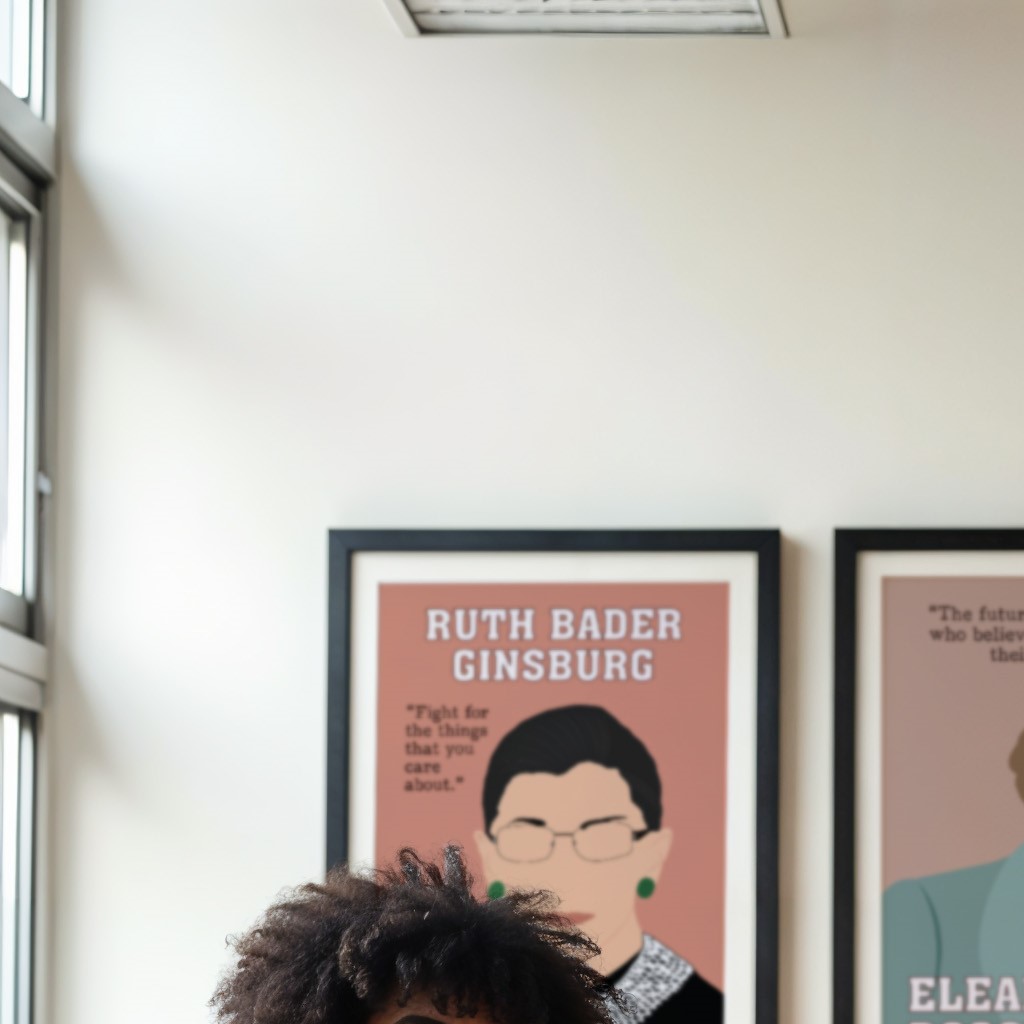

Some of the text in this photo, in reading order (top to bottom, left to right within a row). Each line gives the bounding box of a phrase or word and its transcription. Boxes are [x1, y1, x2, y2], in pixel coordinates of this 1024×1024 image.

[929, 605, 973, 622] "The
[427, 609, 681, 640] RUTH BADER
[930, 627, 966, 642] who
[453, 649, 653, 681] GINSBURG
[406, 704, 489, 722] "Fight for
[405, 723, 488, 741] the things
[405, 740, 474, 759] that you
[404, 761, 441, 774] care
[404, 776, 464, 792] about."
